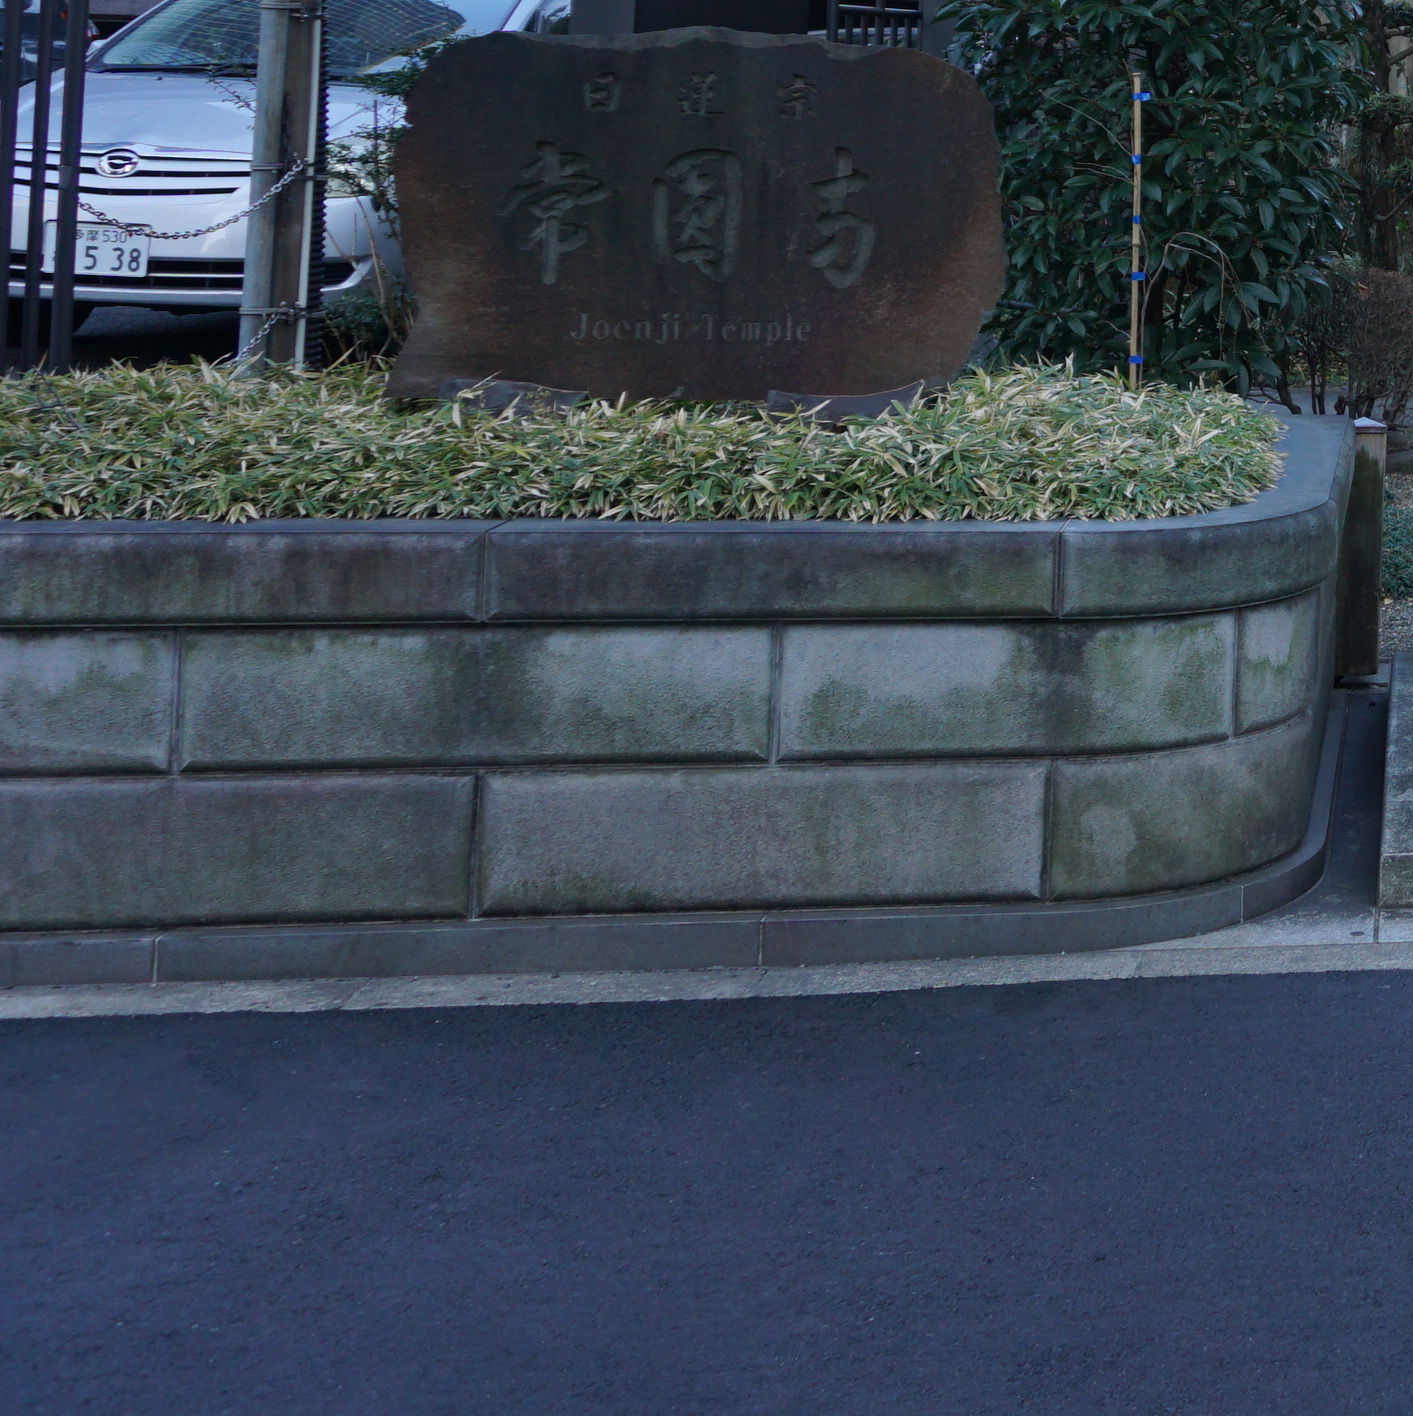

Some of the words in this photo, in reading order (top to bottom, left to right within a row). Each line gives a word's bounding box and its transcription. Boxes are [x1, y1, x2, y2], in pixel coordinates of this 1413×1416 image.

[582, 70, 819, 121] 日蓮宗
[569, 311, 681, 345] Joenji
[700, 312, 813, 347] Temple
